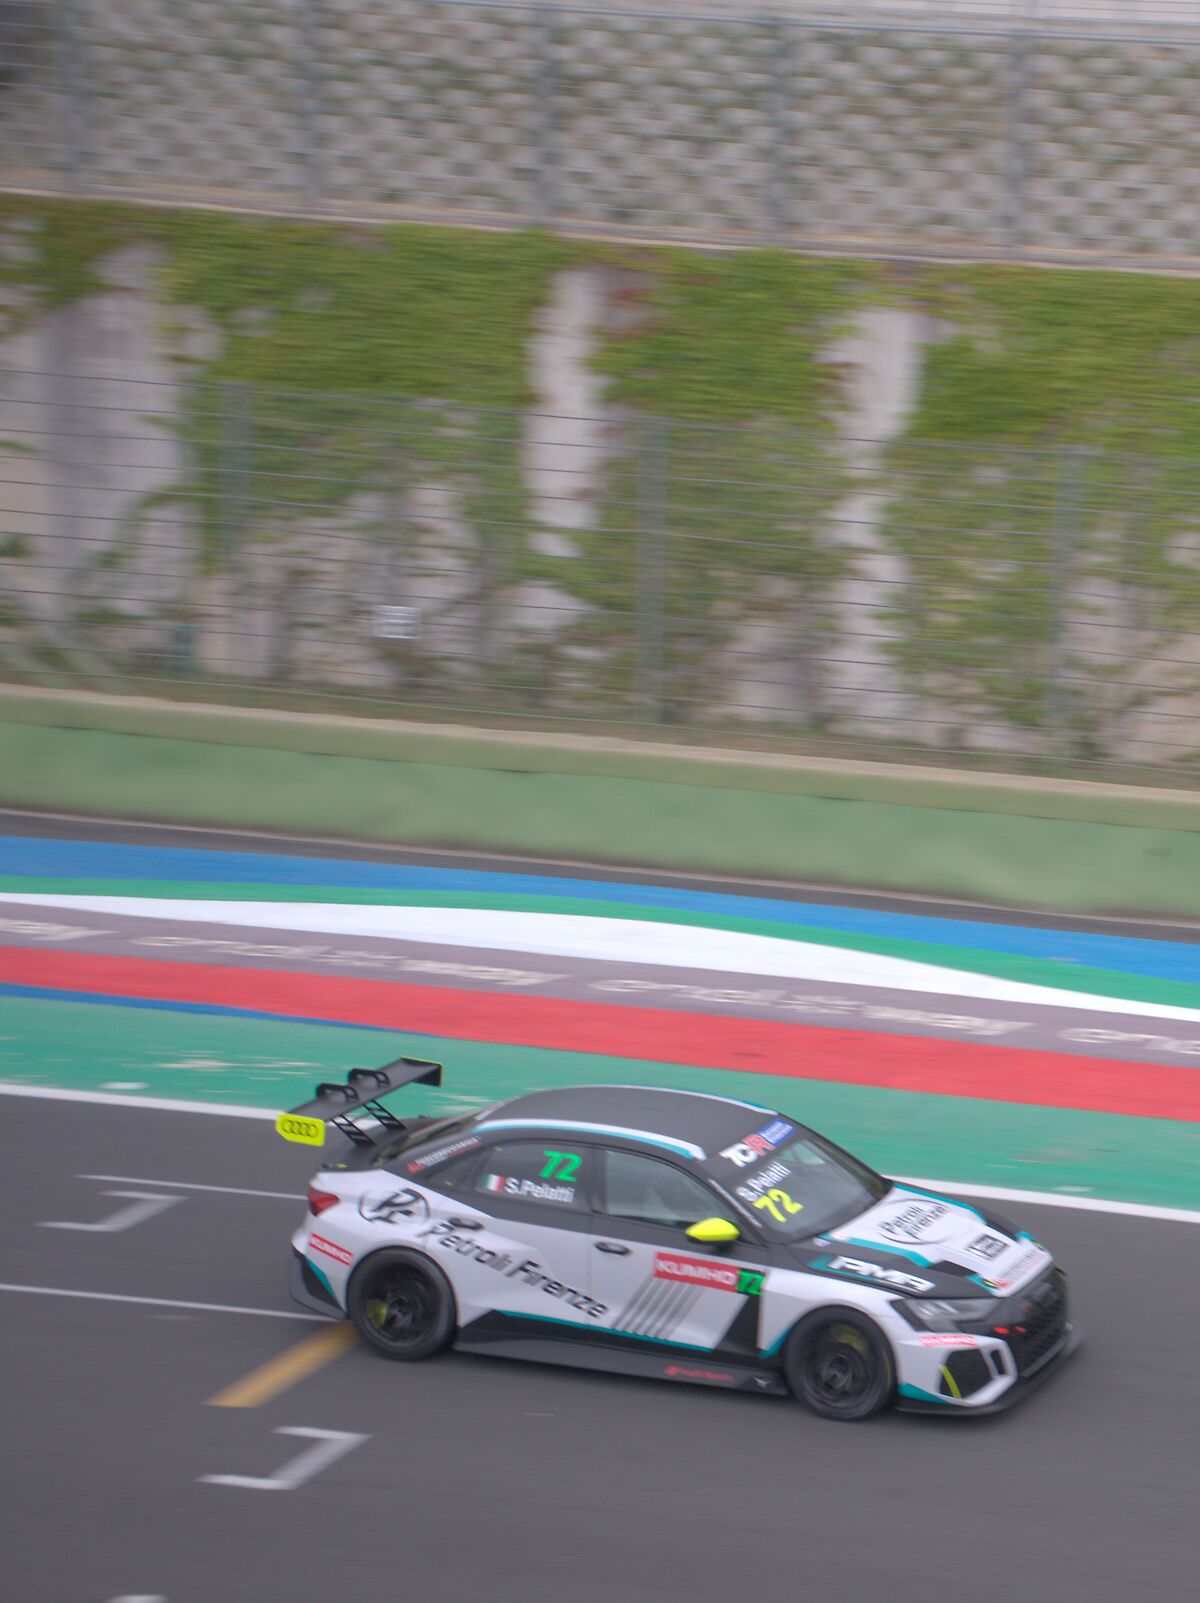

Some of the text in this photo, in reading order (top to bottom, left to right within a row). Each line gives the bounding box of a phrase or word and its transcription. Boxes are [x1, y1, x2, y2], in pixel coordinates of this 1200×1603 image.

[540, 1150, 583, 1183] 72
[719, 1134, 776, 1168] TCR
[752, 1188, 804, 1223] 72
[878, 1205, 926, 1235] Petroli
[416, 1222, 610, 1319] Petroli Firenze
[655, 1260, 738, 1286] KUMHO
